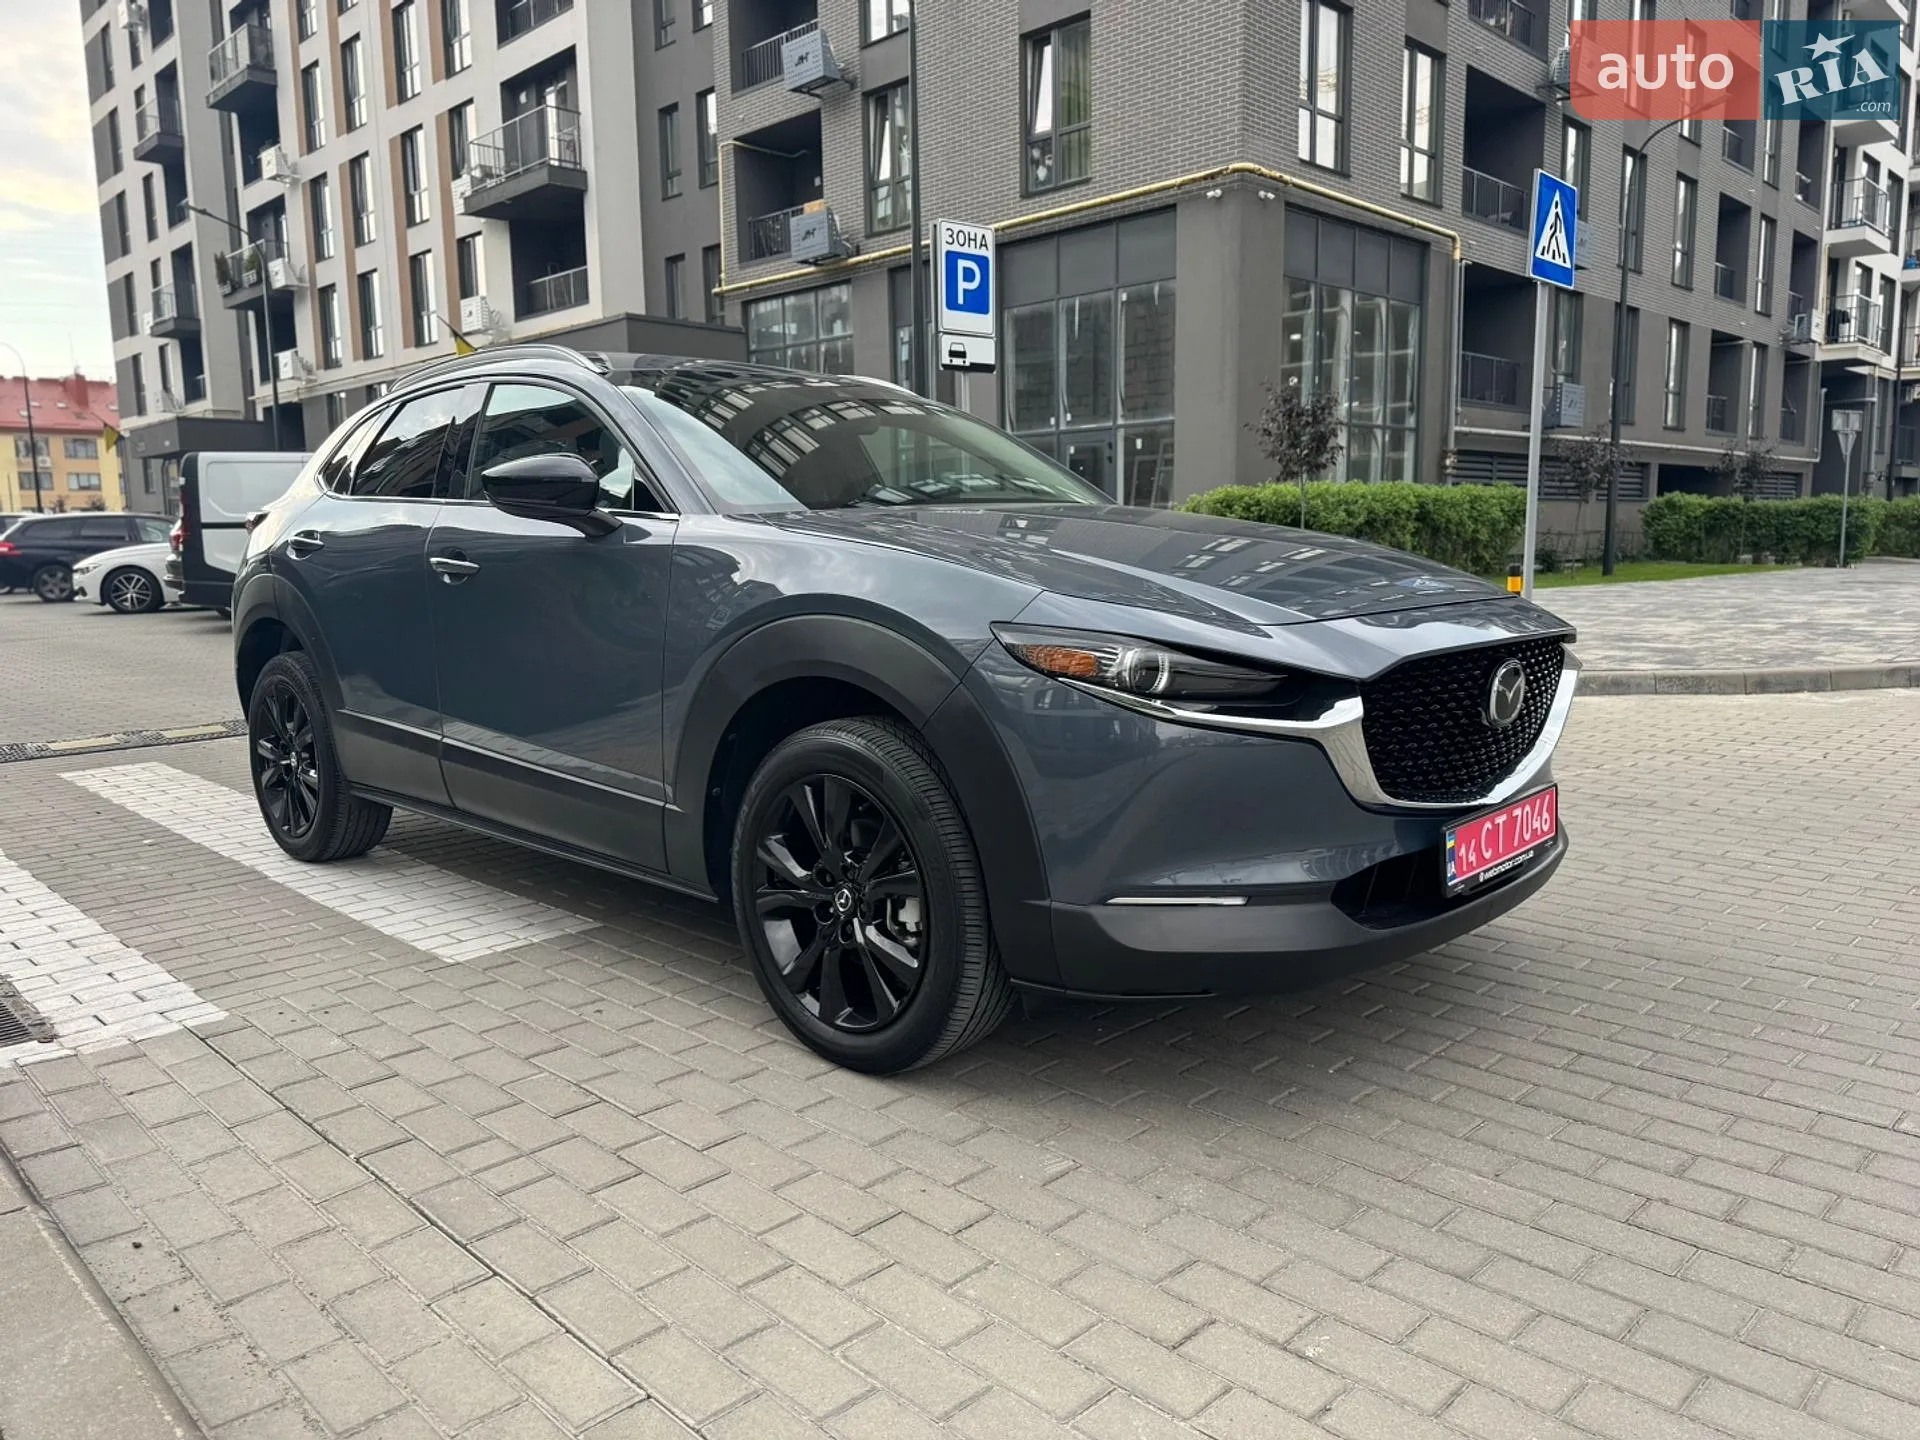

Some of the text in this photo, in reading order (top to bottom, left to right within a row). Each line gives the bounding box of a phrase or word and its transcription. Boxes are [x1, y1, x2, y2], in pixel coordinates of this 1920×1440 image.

[945, 228, 989, 251] ЗОНА
[957, 258, 982, 305] P
[1458, 838, 1477, 872] 14
[1511, 794, 1551, 848] 7046
